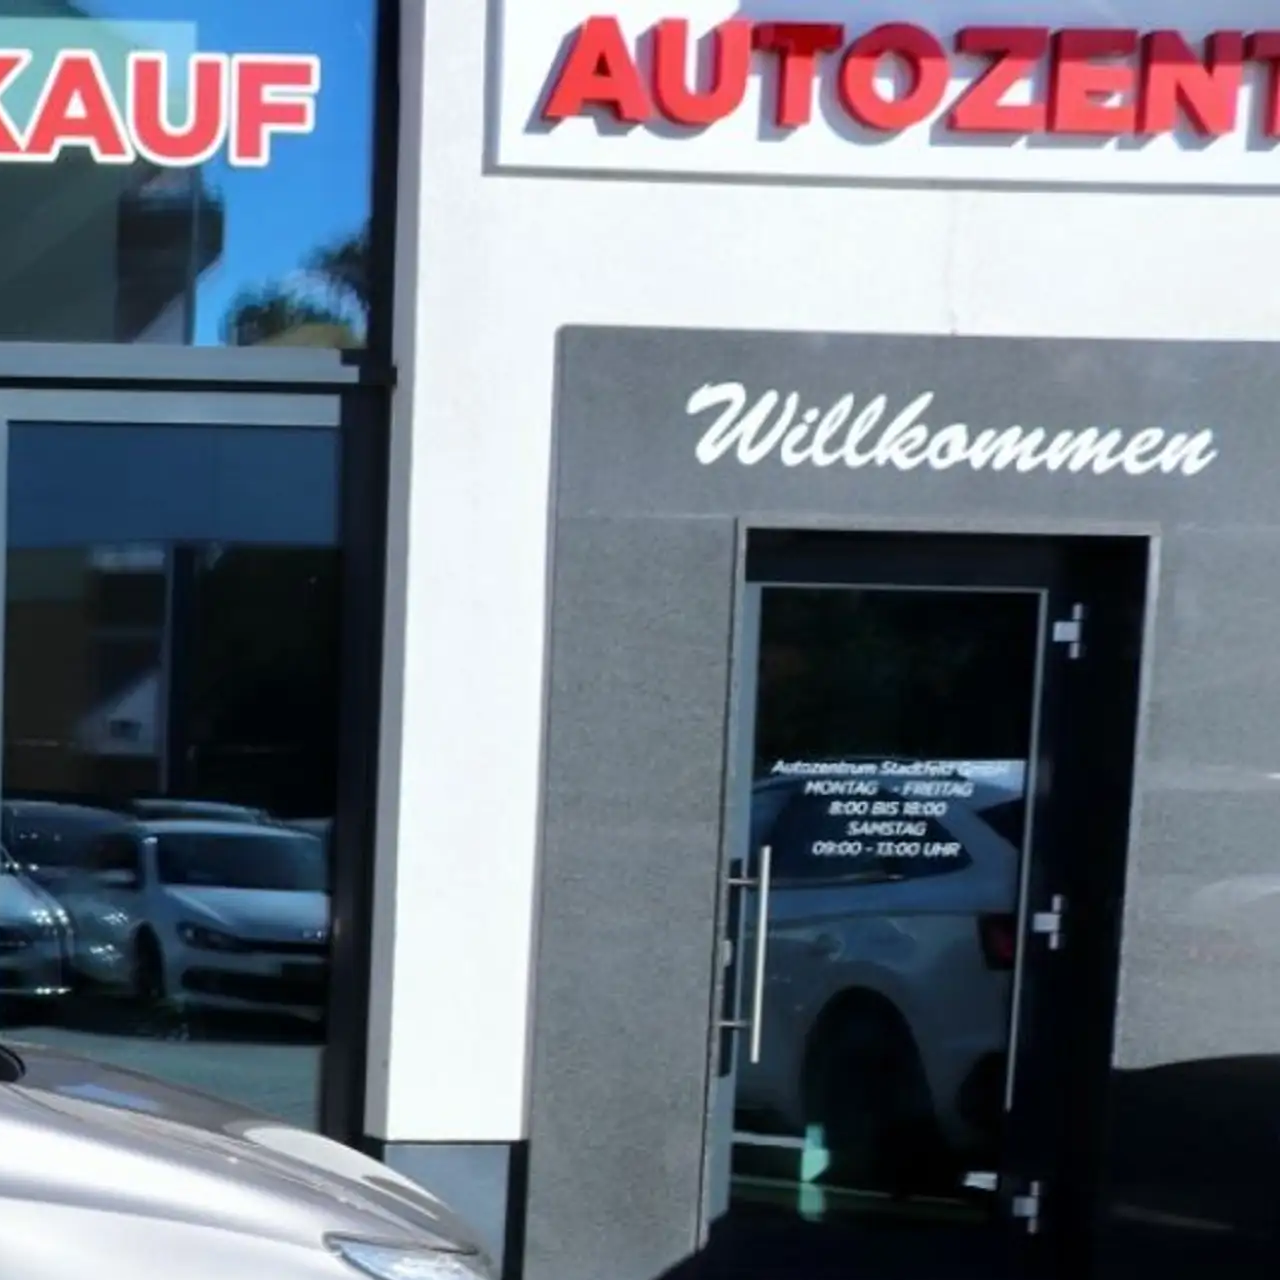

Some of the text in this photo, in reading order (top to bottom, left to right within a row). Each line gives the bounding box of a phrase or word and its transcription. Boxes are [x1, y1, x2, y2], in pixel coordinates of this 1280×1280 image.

[686, 381, 1218, 475] Willkommen
[804, 781, 879, 796] MONTAG
[901, 781, 975, 797] FREITAG
[871, 801, 898, 816] BIS
[847, 821, 928, 836] SAMSTAG
[923, 841, 961, 857] UHR
